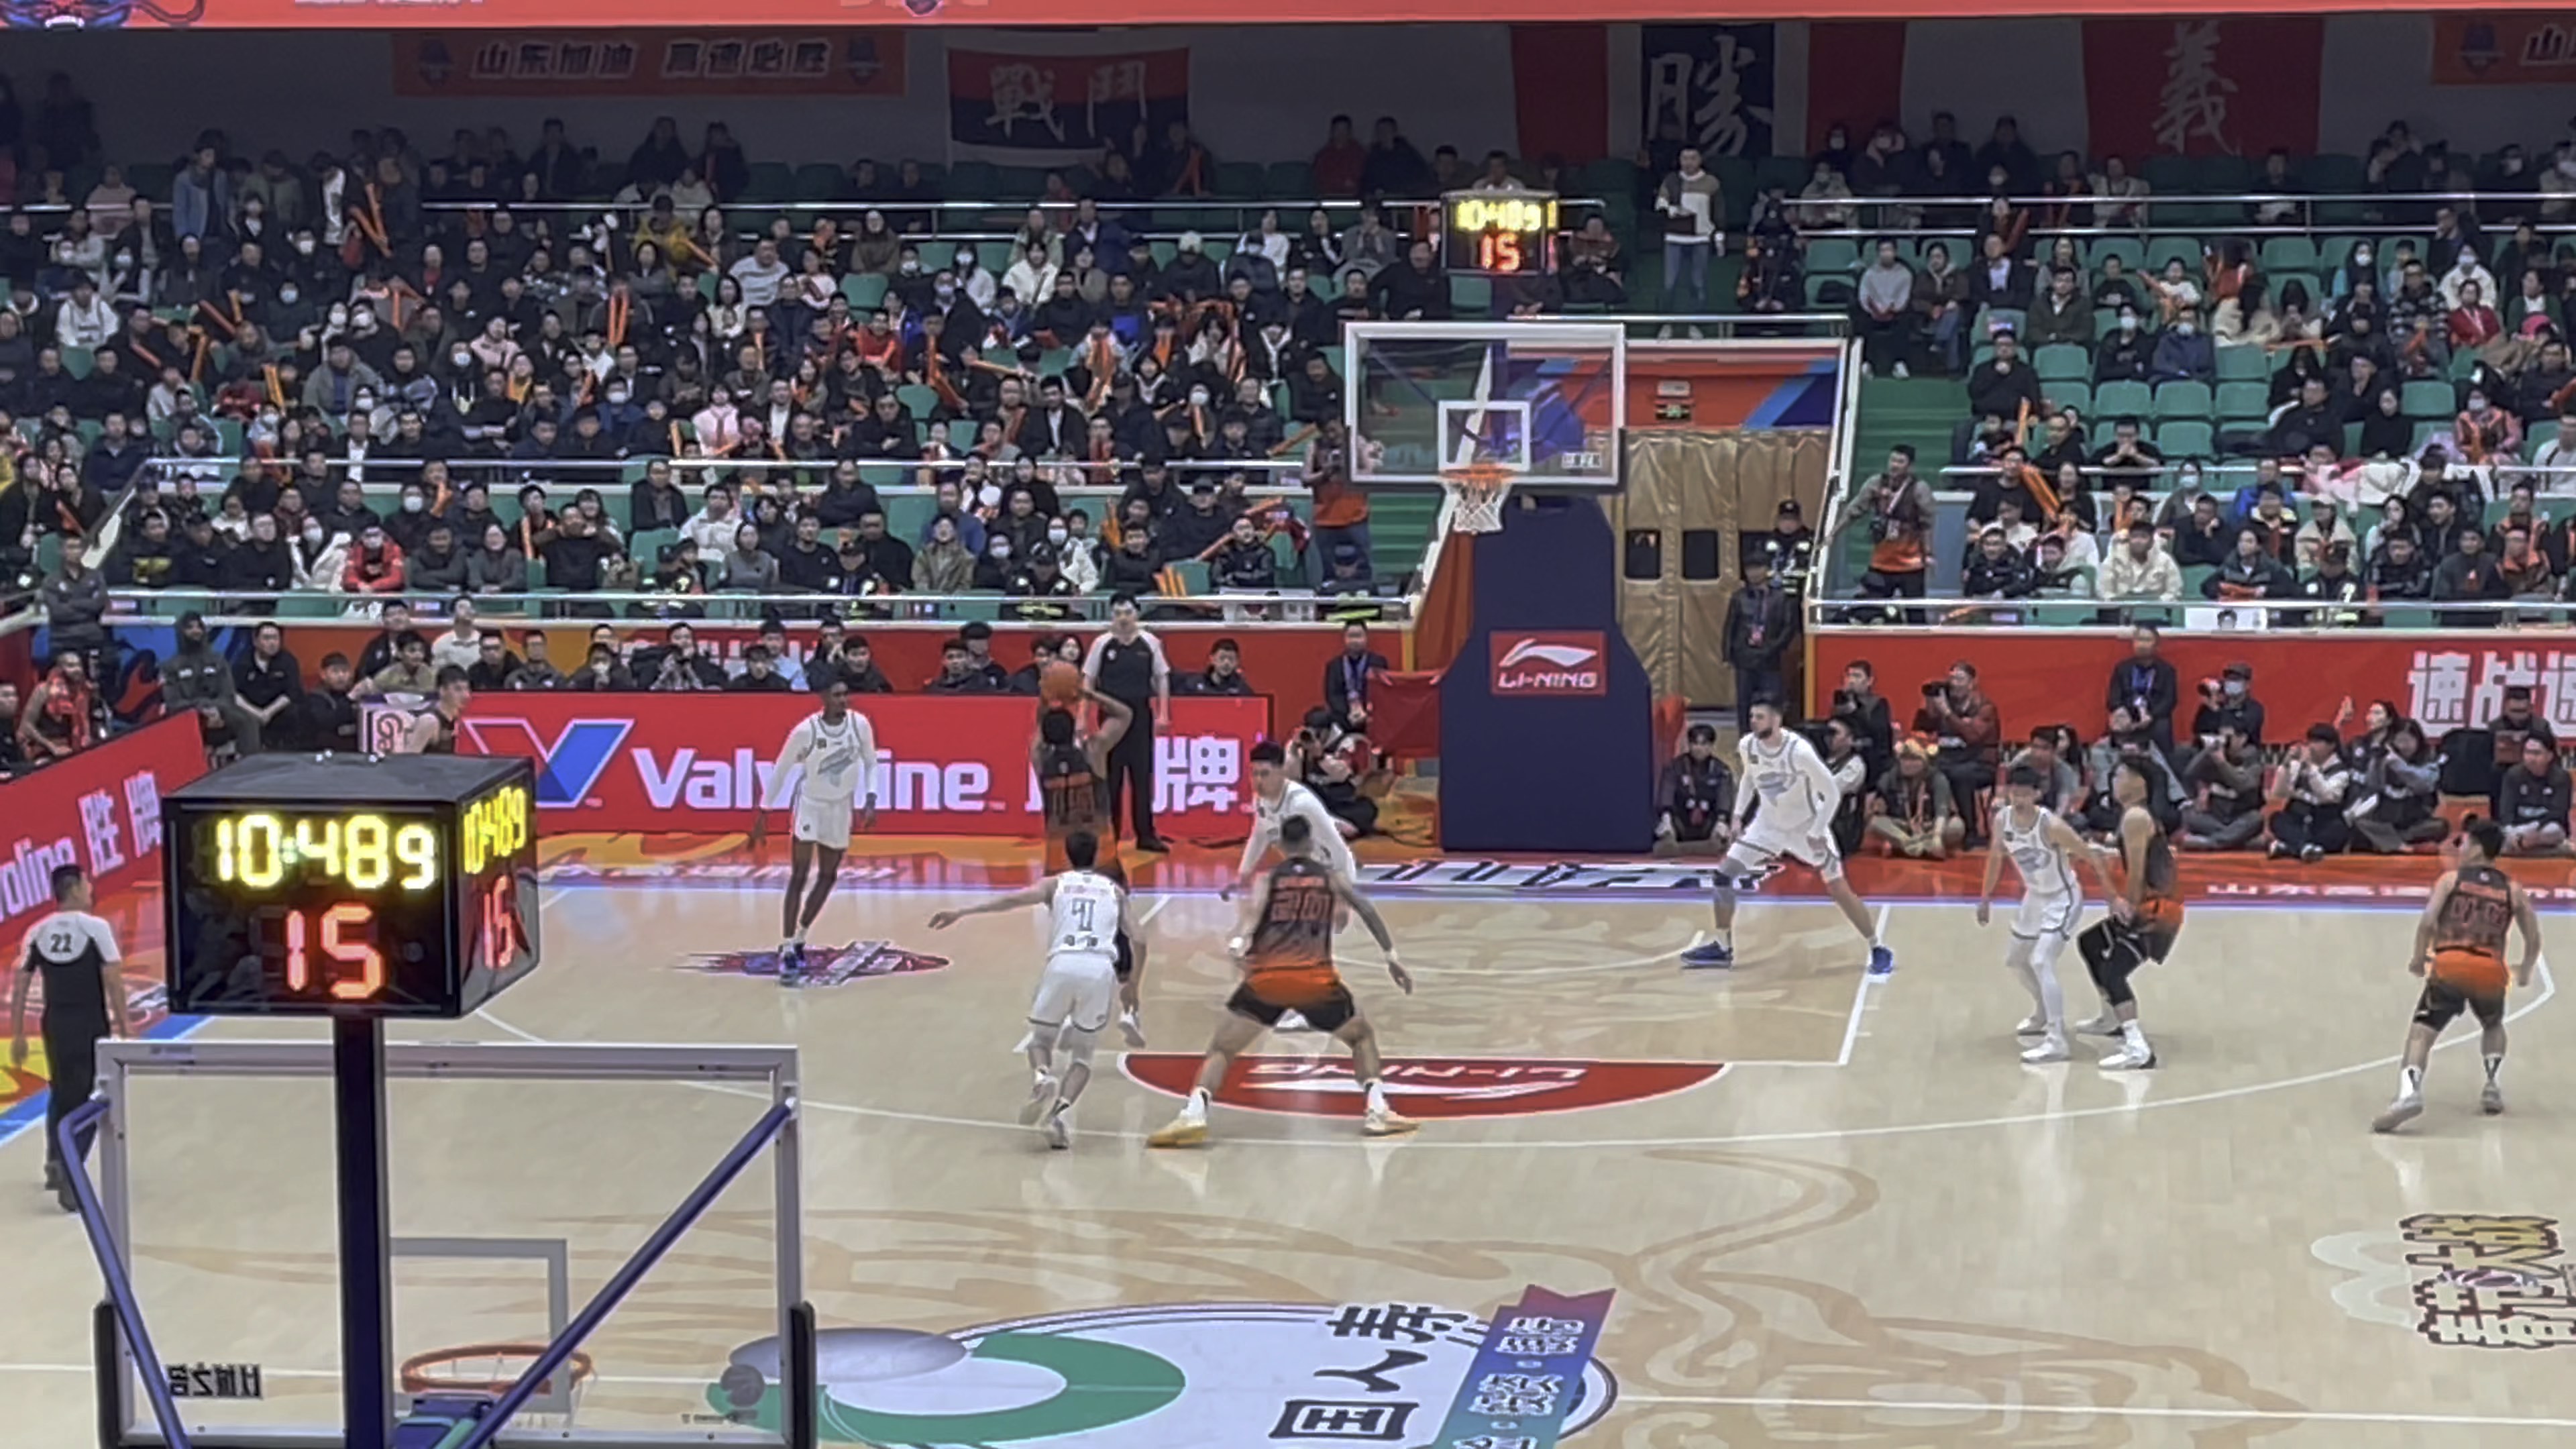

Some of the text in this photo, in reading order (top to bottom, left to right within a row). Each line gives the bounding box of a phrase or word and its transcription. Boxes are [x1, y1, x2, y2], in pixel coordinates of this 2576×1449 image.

[1481, 232, 1521, 270] 15
[1498, 672, 1597, 688] LI-NING
[630, 747, 990, 811] Valvine
[50, 933, 72, 953] 22
[285, 902, 384, 1000] 15
